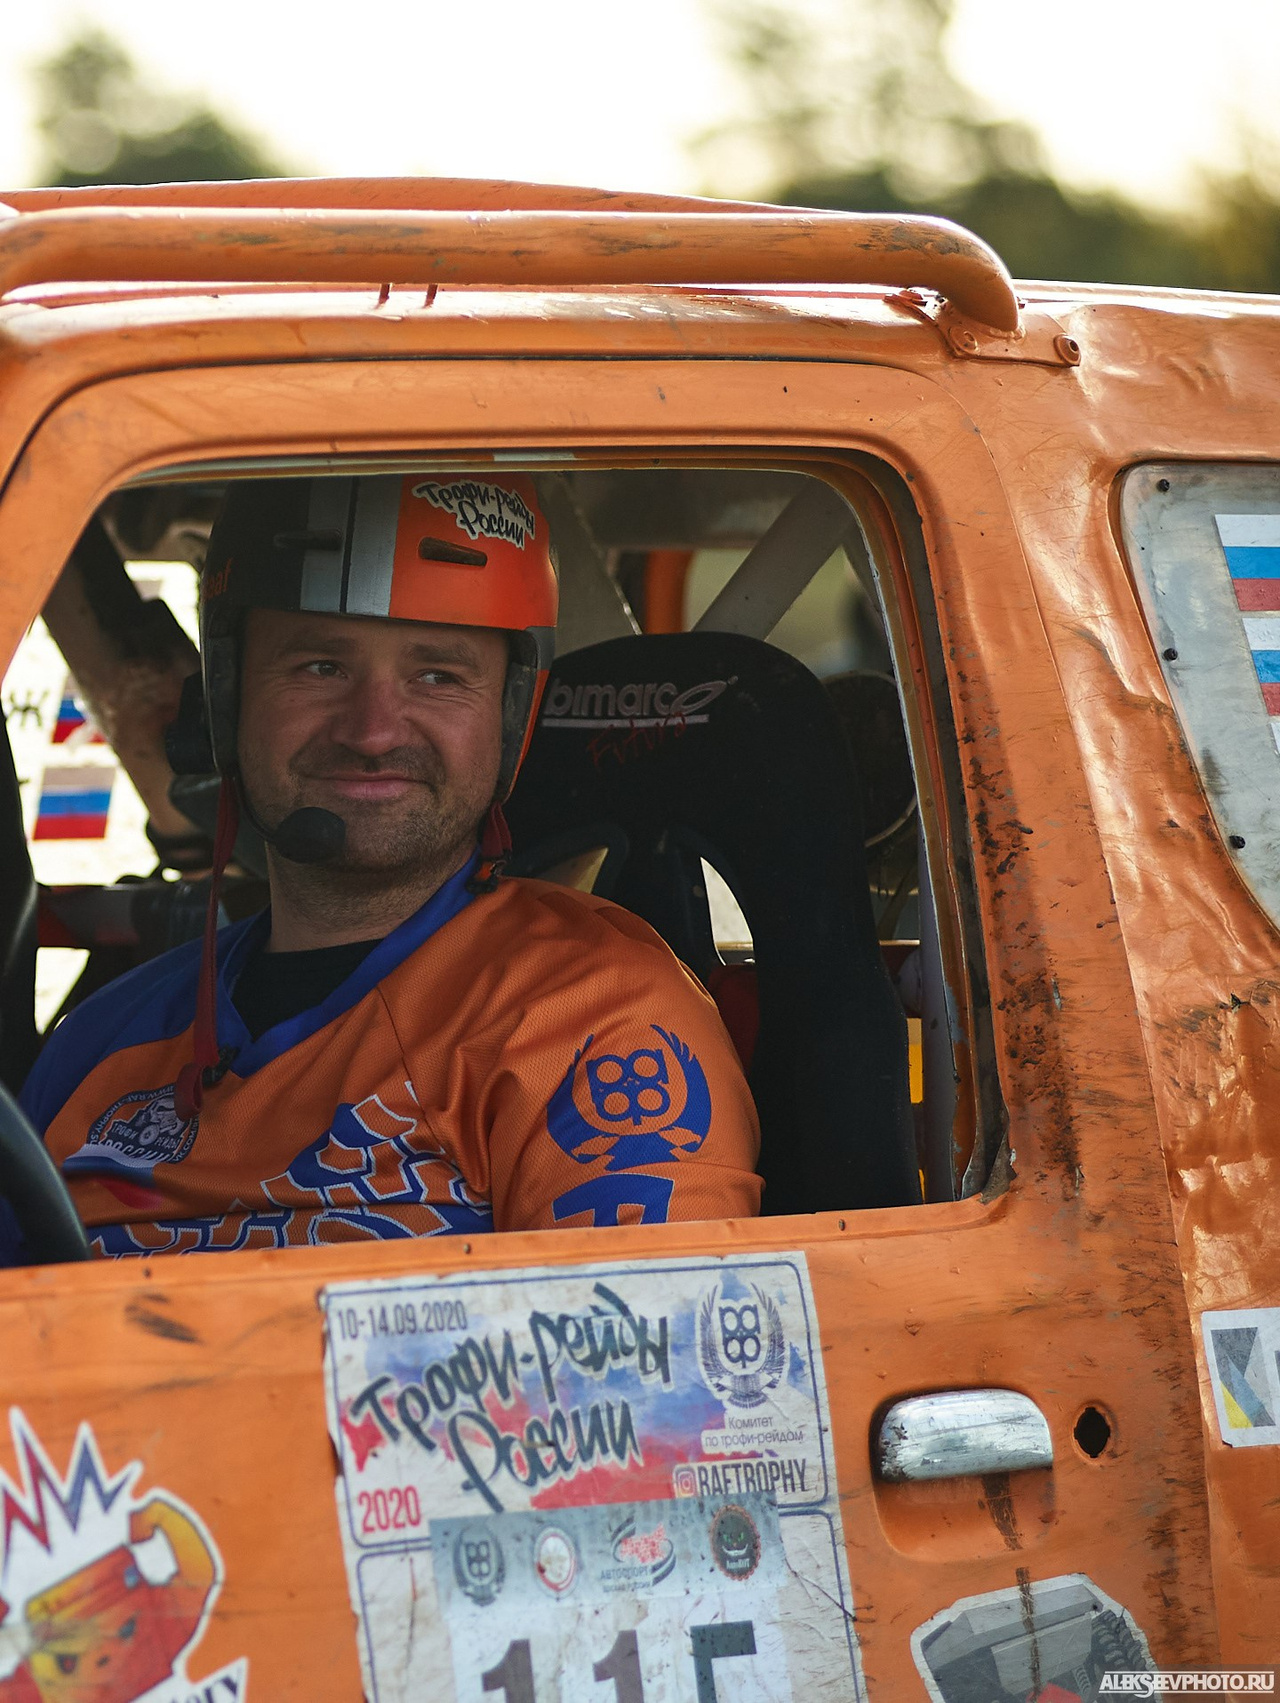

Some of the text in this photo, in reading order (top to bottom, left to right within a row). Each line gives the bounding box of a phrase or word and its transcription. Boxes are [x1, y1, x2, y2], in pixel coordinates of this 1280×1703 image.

[458, 500, 524, 546] России
[349, 1281, 672, 1452] Трофи-рейды
[728, 1416, 774, 1430] Комитет
[446, 1399, 641, 1514] России
[358, 1485, 422, 1534] 2020
